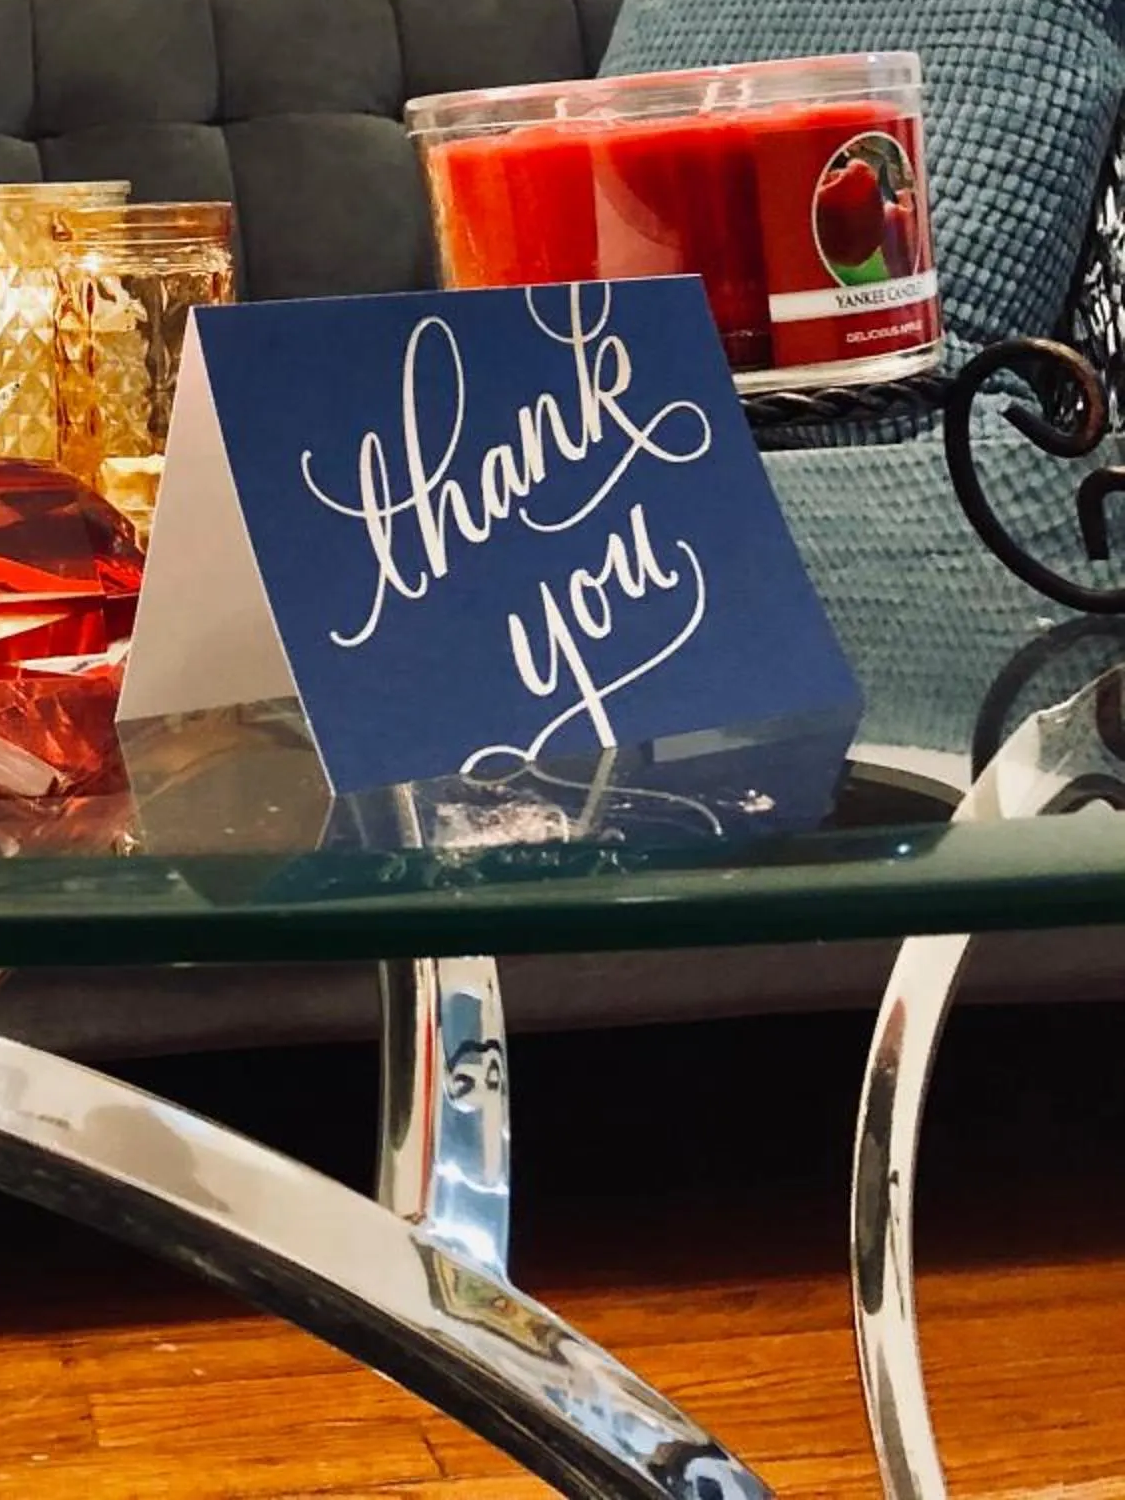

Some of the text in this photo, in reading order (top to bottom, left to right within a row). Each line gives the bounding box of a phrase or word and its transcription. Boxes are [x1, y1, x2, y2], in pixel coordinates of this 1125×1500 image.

[835, 289, 885, 309] YANKEE
[302, 281, 712, 647] thank
[459, 503, 706, 776] you
